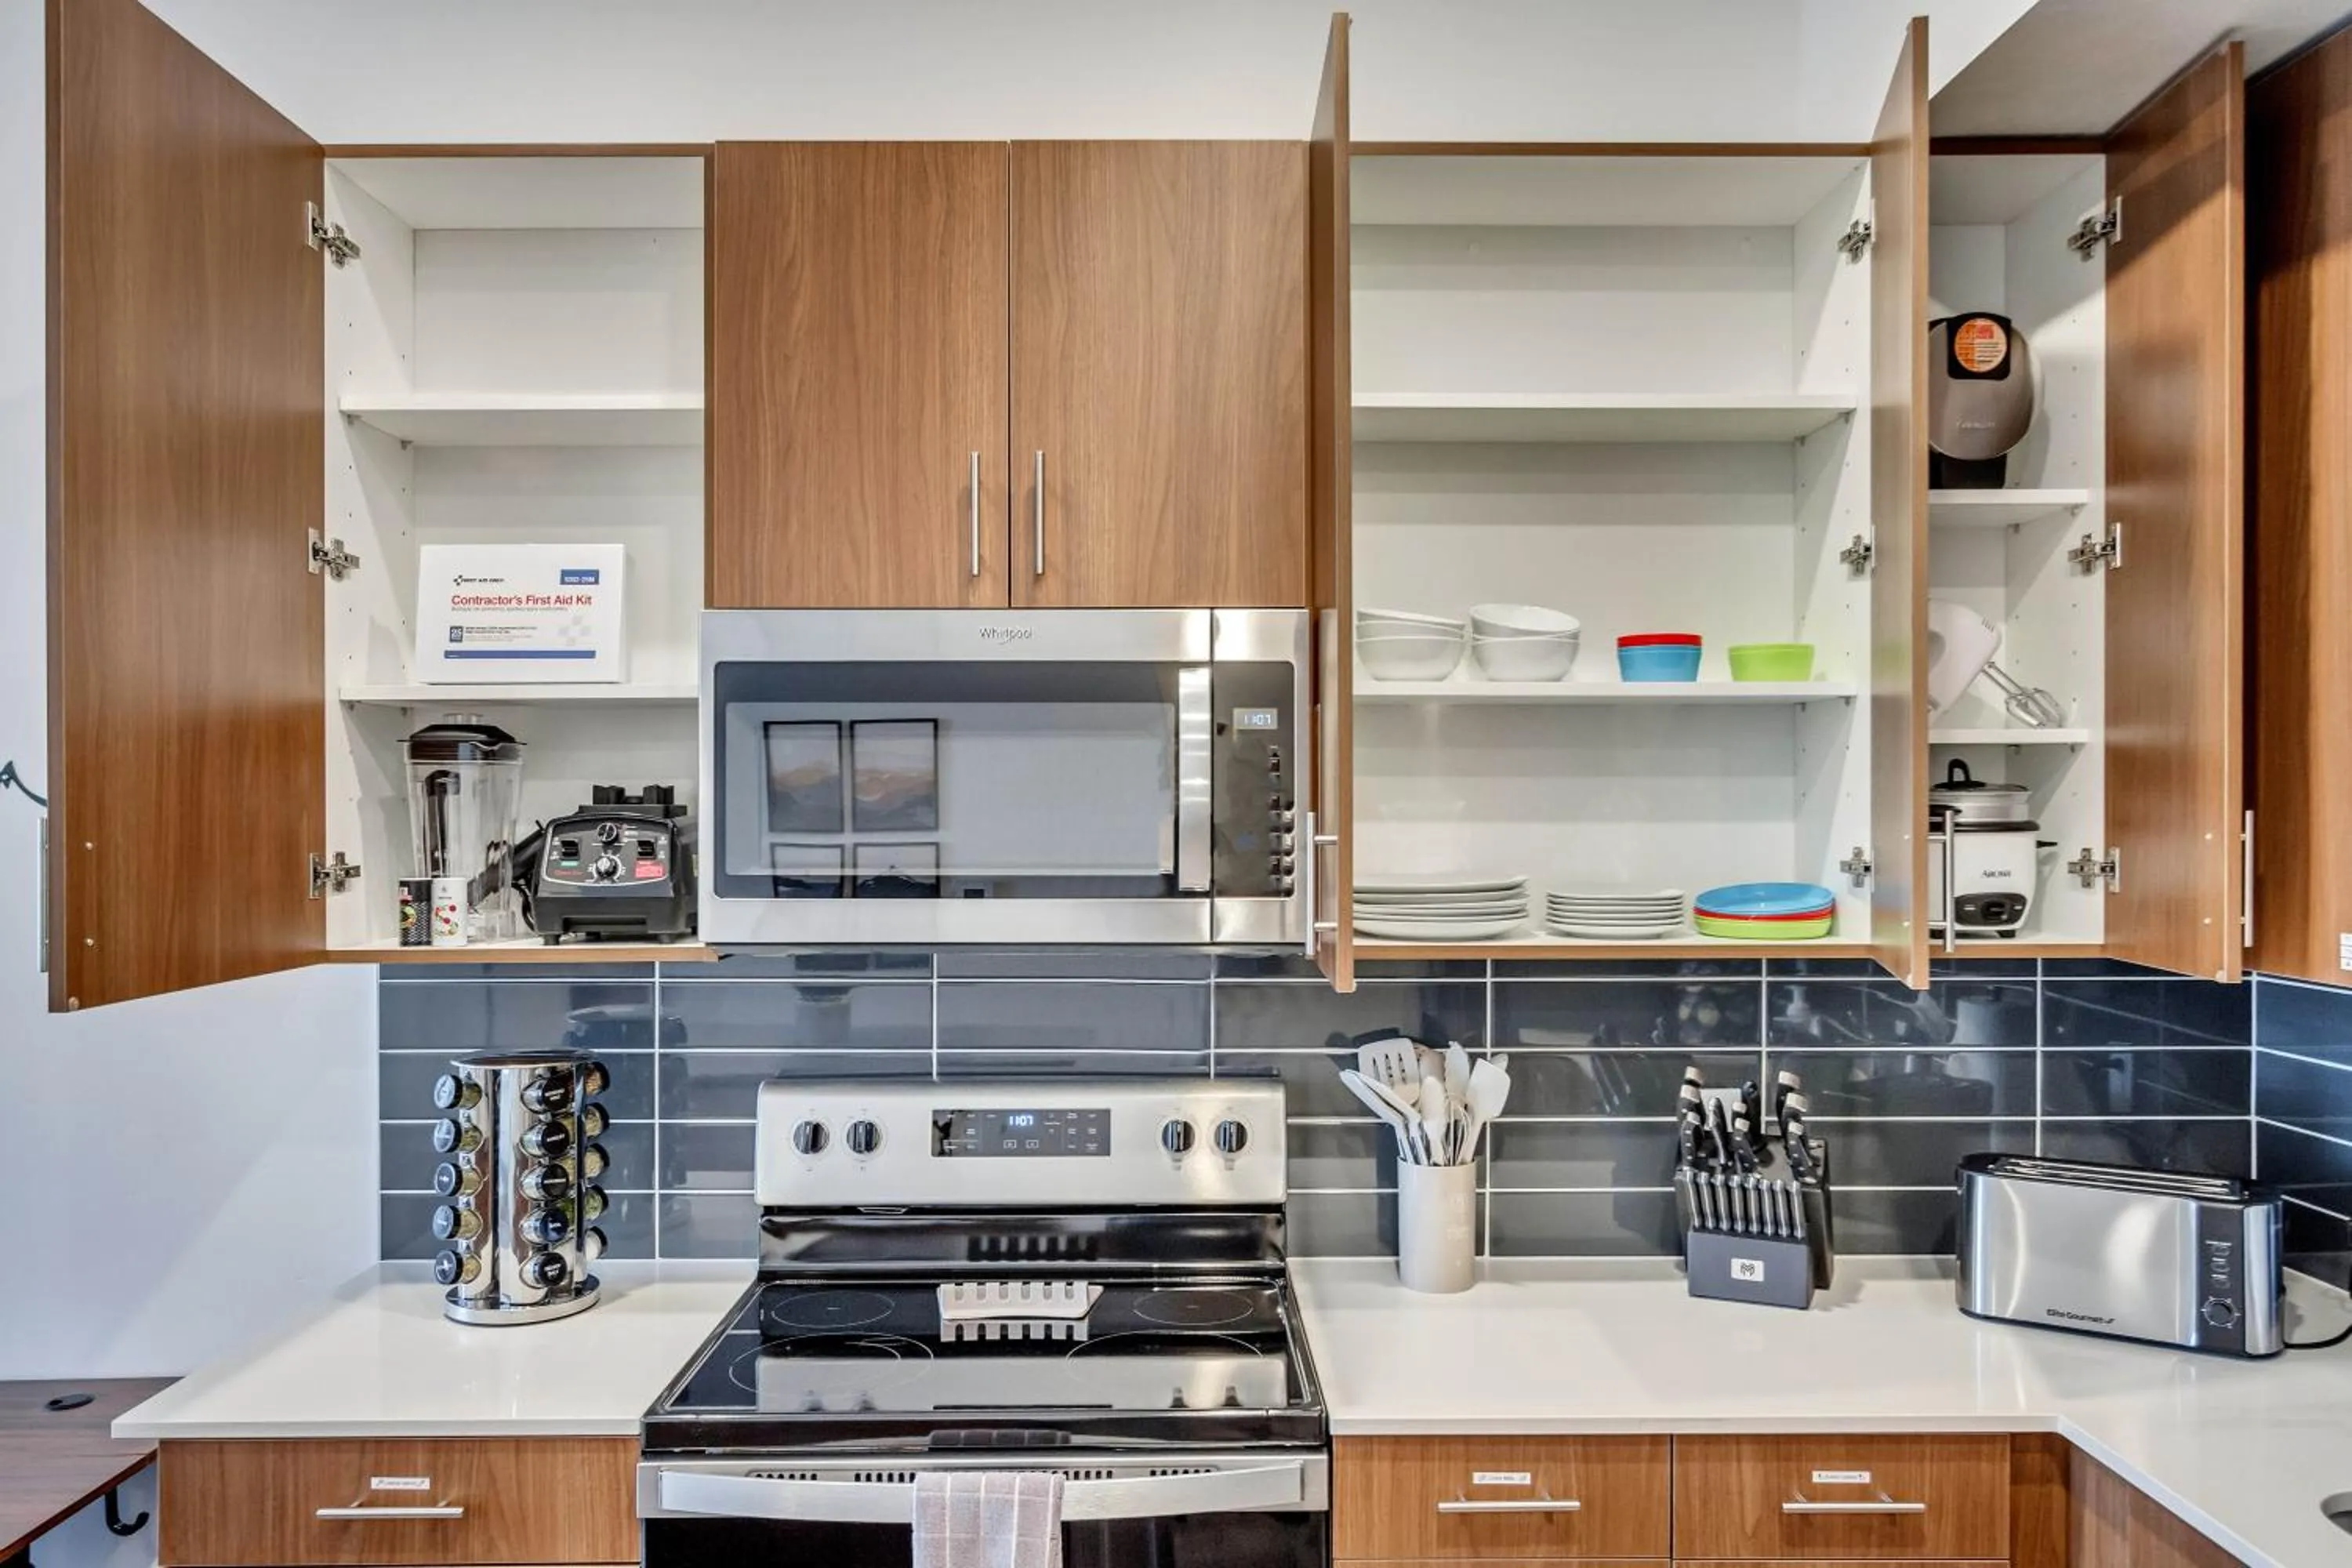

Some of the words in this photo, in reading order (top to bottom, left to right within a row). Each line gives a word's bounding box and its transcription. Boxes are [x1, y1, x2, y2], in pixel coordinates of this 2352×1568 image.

[451, 595, 523, 605] Contractor's
[526, 595, 550, 605] First
[554, 595, 572, 605] Aid
[576, 595, 592, 605] Kit
[979, 626, 1034, 642] Whirlpool
